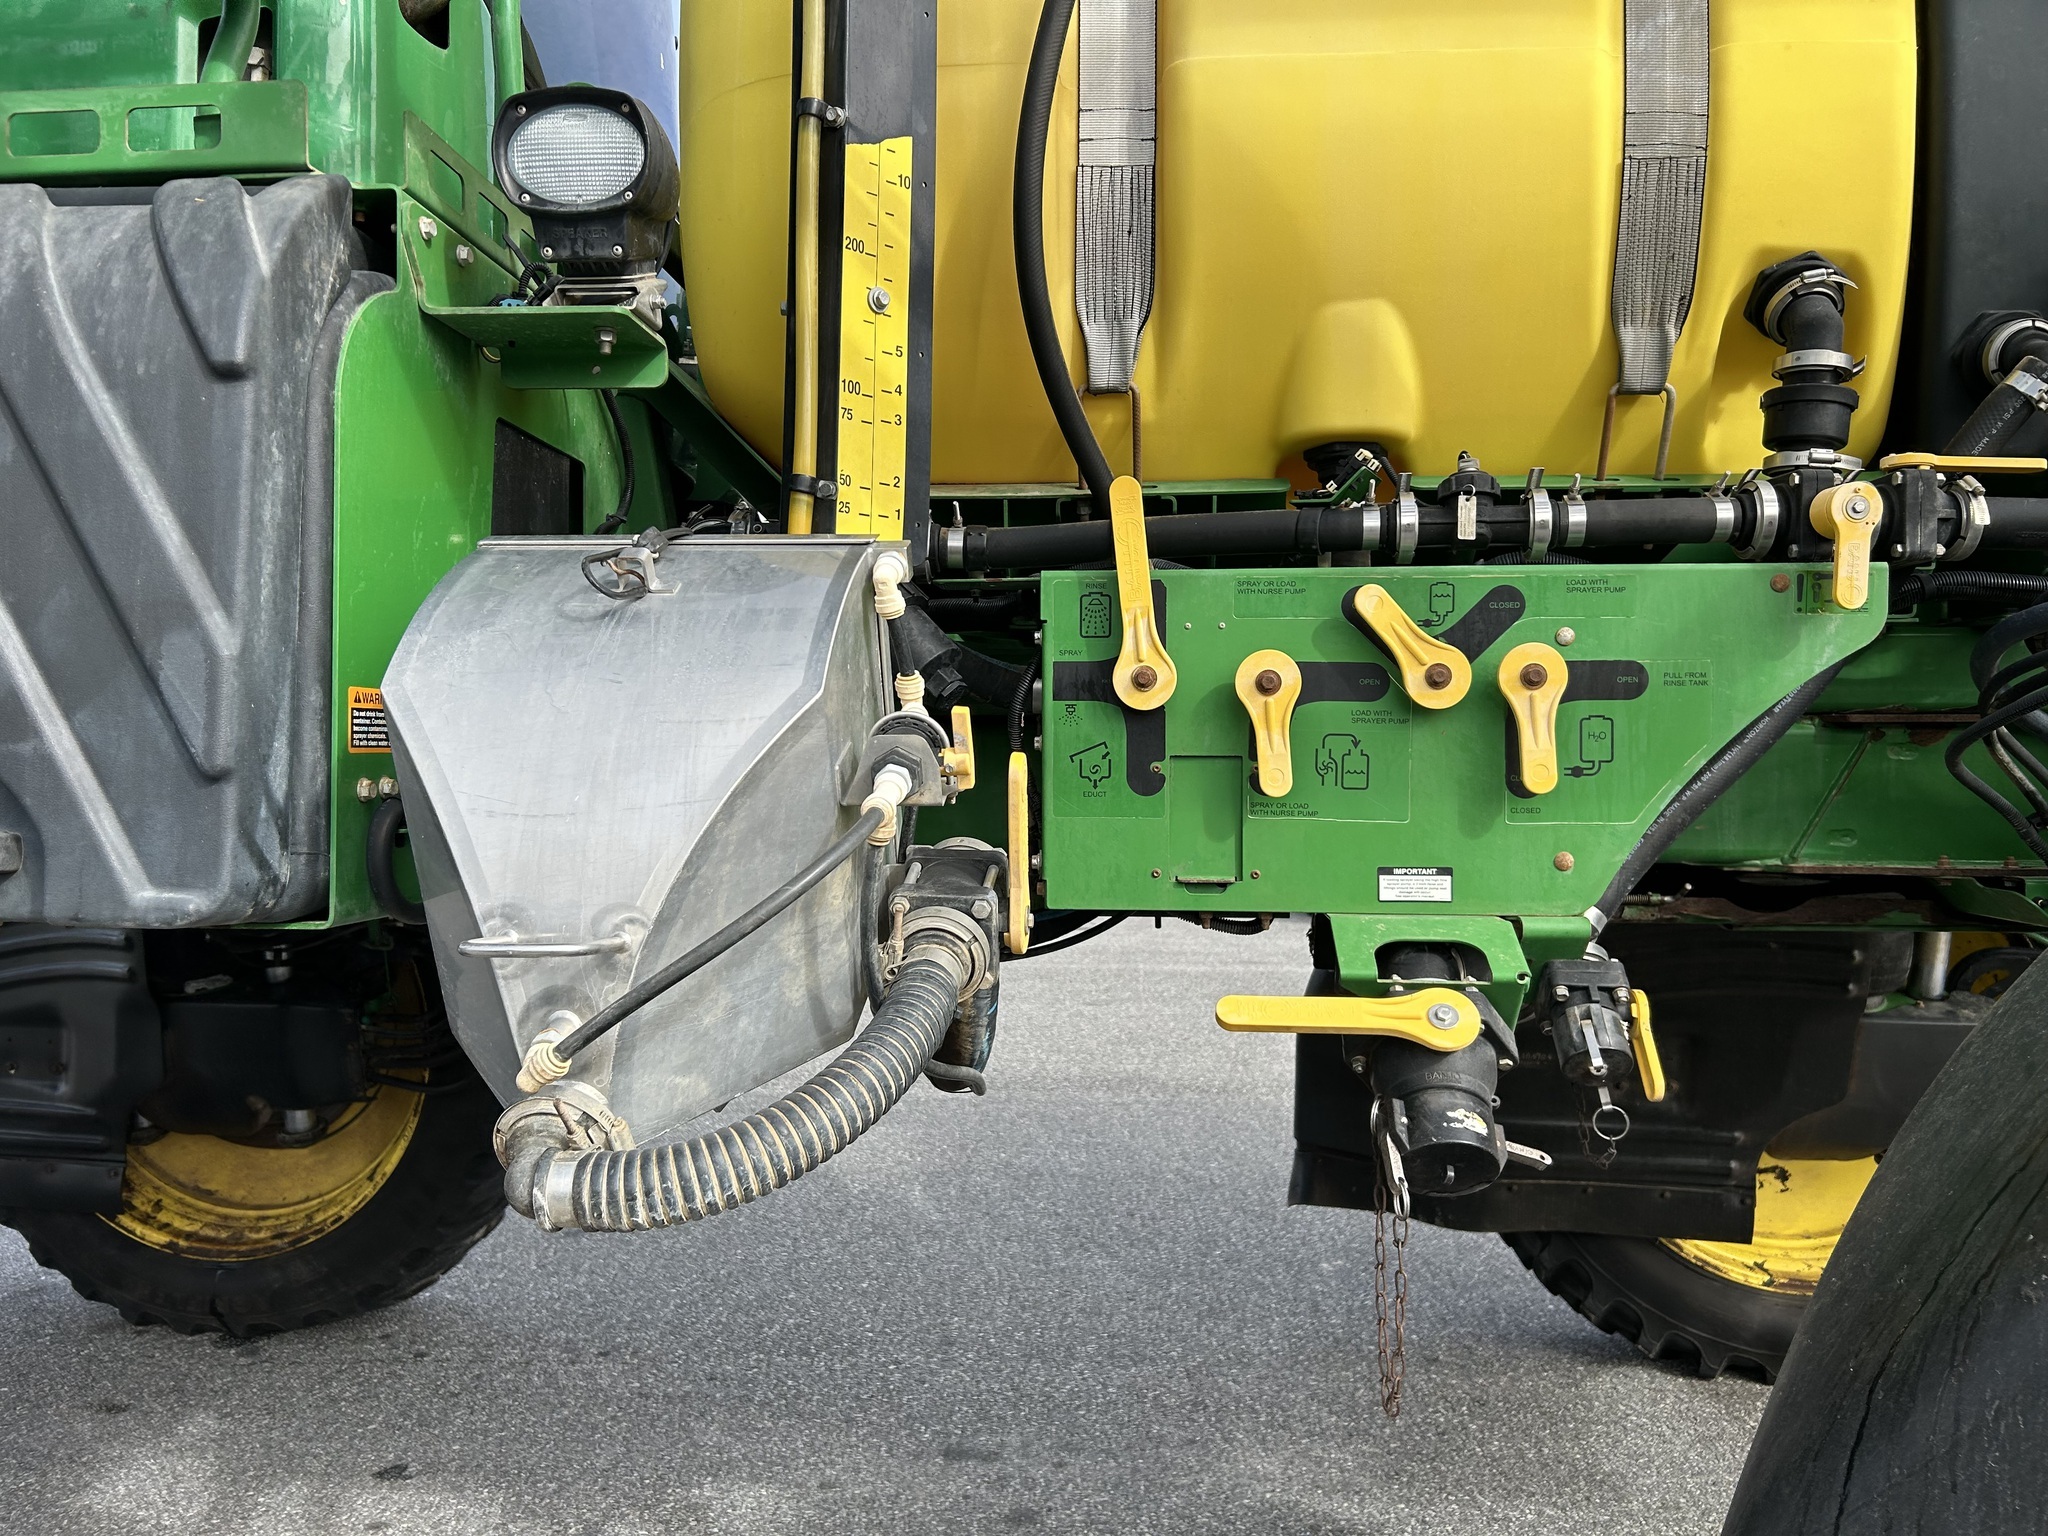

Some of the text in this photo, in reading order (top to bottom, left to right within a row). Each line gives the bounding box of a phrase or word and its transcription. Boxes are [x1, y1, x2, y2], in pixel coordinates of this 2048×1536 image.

[898, 174, 910, 189] 10
[552, 227, 608, 238] SPEAKER
[845, 236, 864, 254] 200
[895, 345, 903, 357] 5
[842, 378, 860, 395] 100
[894, 384, 902, 396] 4
[2015, 396, 2026, 408] 200
[841, 406, 853, 420] 75
[2002, 408, 2014, 420] PSI
[894, 414, 902, 426] 3
[1971, 436, 1990, 456] MADE
[840, 474, 851, 487] 50
[893, 476, 900, 488] 2
[838, 501, 850, 514] 25
[895, 509, 900, 520] 1
[1701, 772, 1712, 781] 200
[1691, 781, 1702, 790] PSI
[1679, 791, 1692, 801] W.P.
[1663, 802, 1680, 818] MADE
[1646, 824, 1658, 834] USA
